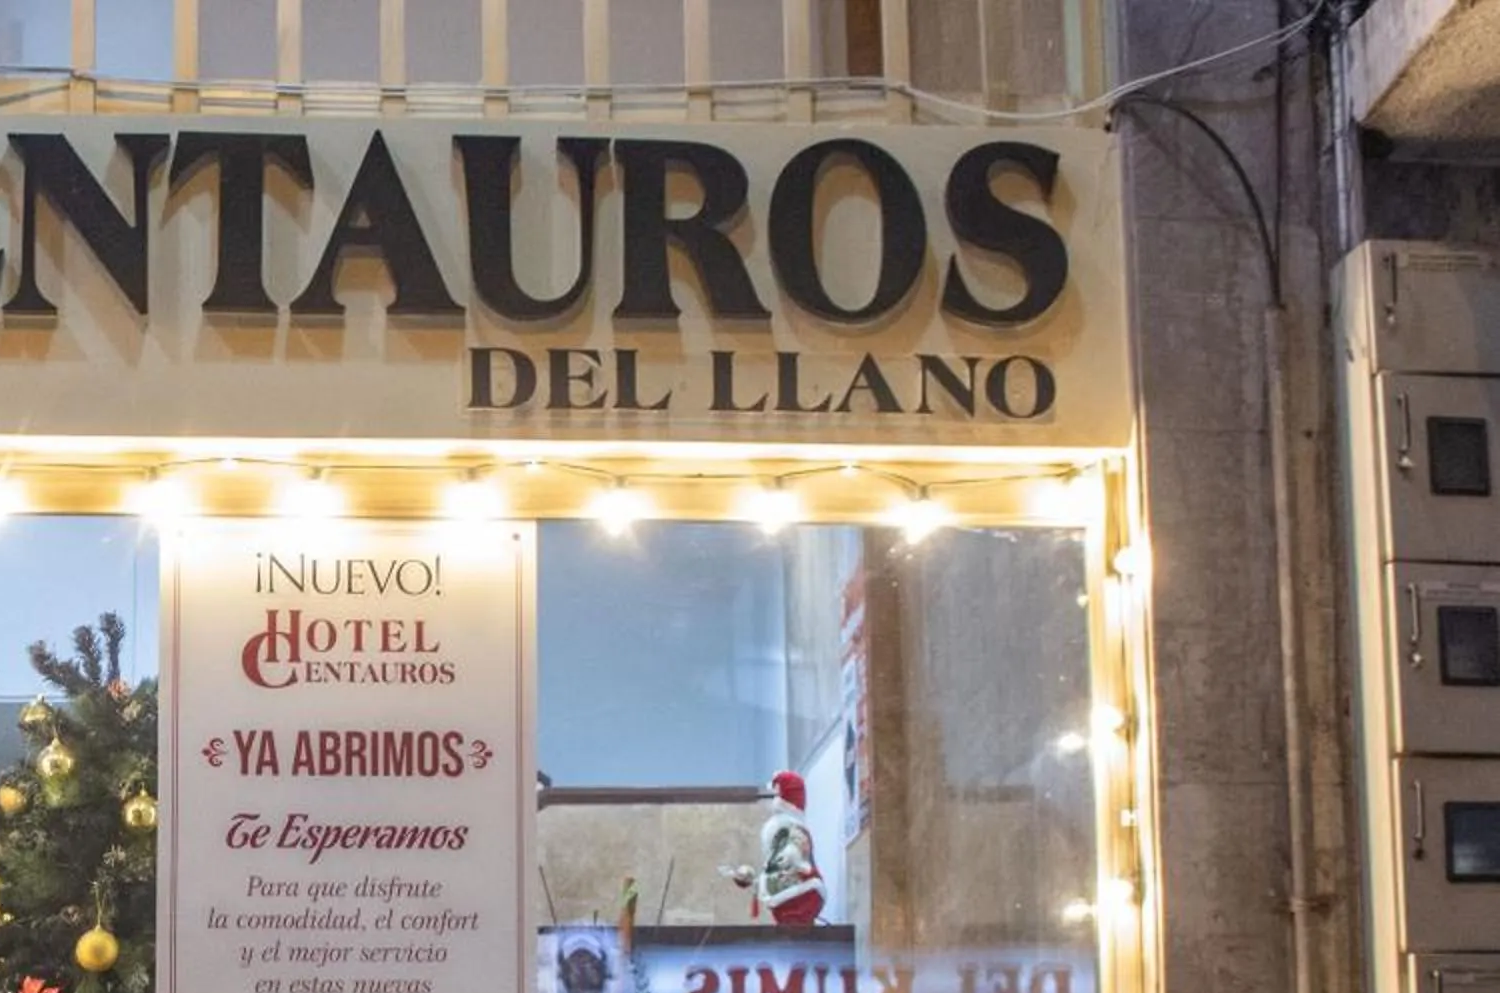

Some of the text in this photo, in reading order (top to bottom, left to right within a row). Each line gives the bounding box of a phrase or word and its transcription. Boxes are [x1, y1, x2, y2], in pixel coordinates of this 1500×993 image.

[466, 346, 1057, 420] DEL LLANO
[255, 552, 443, 597] ¡NUEVO!
[241, 630, 456, 690] CENTAUROS
[264, 608, 441, 664] HOTEL
[233, 729, 465, 777] YA ABRIMOS
[225, 812, 469, 865] Te Esperamos
[246, 874, 443, 903] Para que disfrute
[206, 907, 479, 936] la comodidad, el confort
[238, 940, 448, 969] y el mejor servicio
